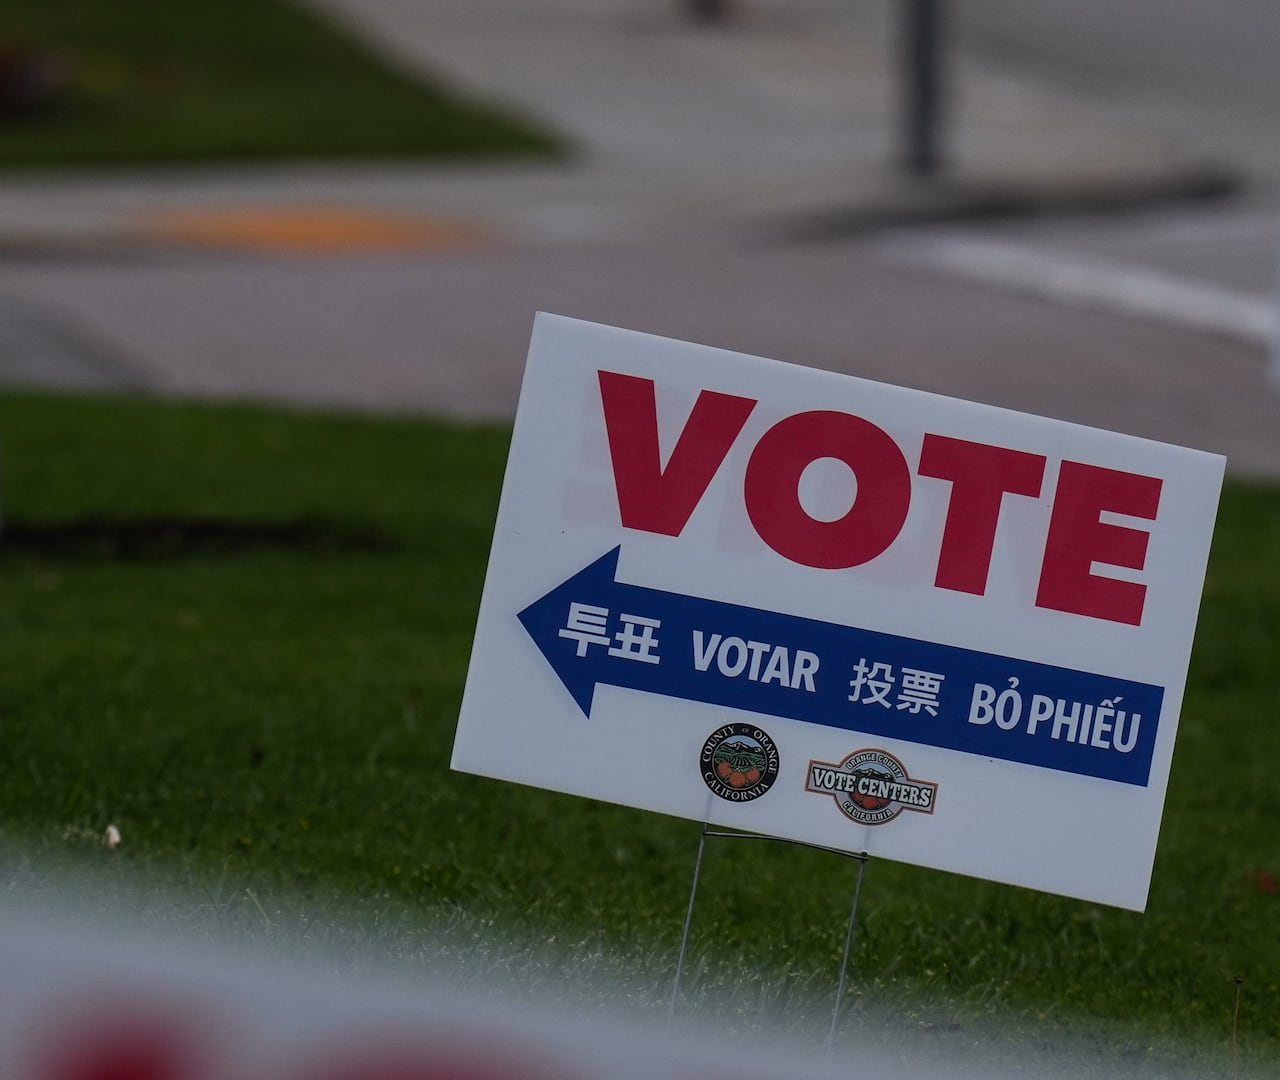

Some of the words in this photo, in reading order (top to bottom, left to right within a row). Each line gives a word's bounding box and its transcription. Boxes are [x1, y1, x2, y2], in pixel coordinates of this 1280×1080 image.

[597, 370, 1164, 627] VOTE
[558, 602, 661, 665] 투표
[692, 630, 820, 692] VOTAR
[848, 658, 946, 717] 投票
[968, 676, 1023, 730] BỎ
[1026, 695, 1142, 753] PHIẾU
[703, 725, 735, 762] COUNTY
[753, 730, 777, 774] ORANGE
[846, 753, 877, 769] ORANGE
[878, 754, 904, 778] COUNTY
[705, 771, 769, 800] CALIFORNIA
[813, 767, 856, 793] VOTE
[858, 776, 932, 807] CENTERS
[842, 801, 894, 821] CALIFORNIA
